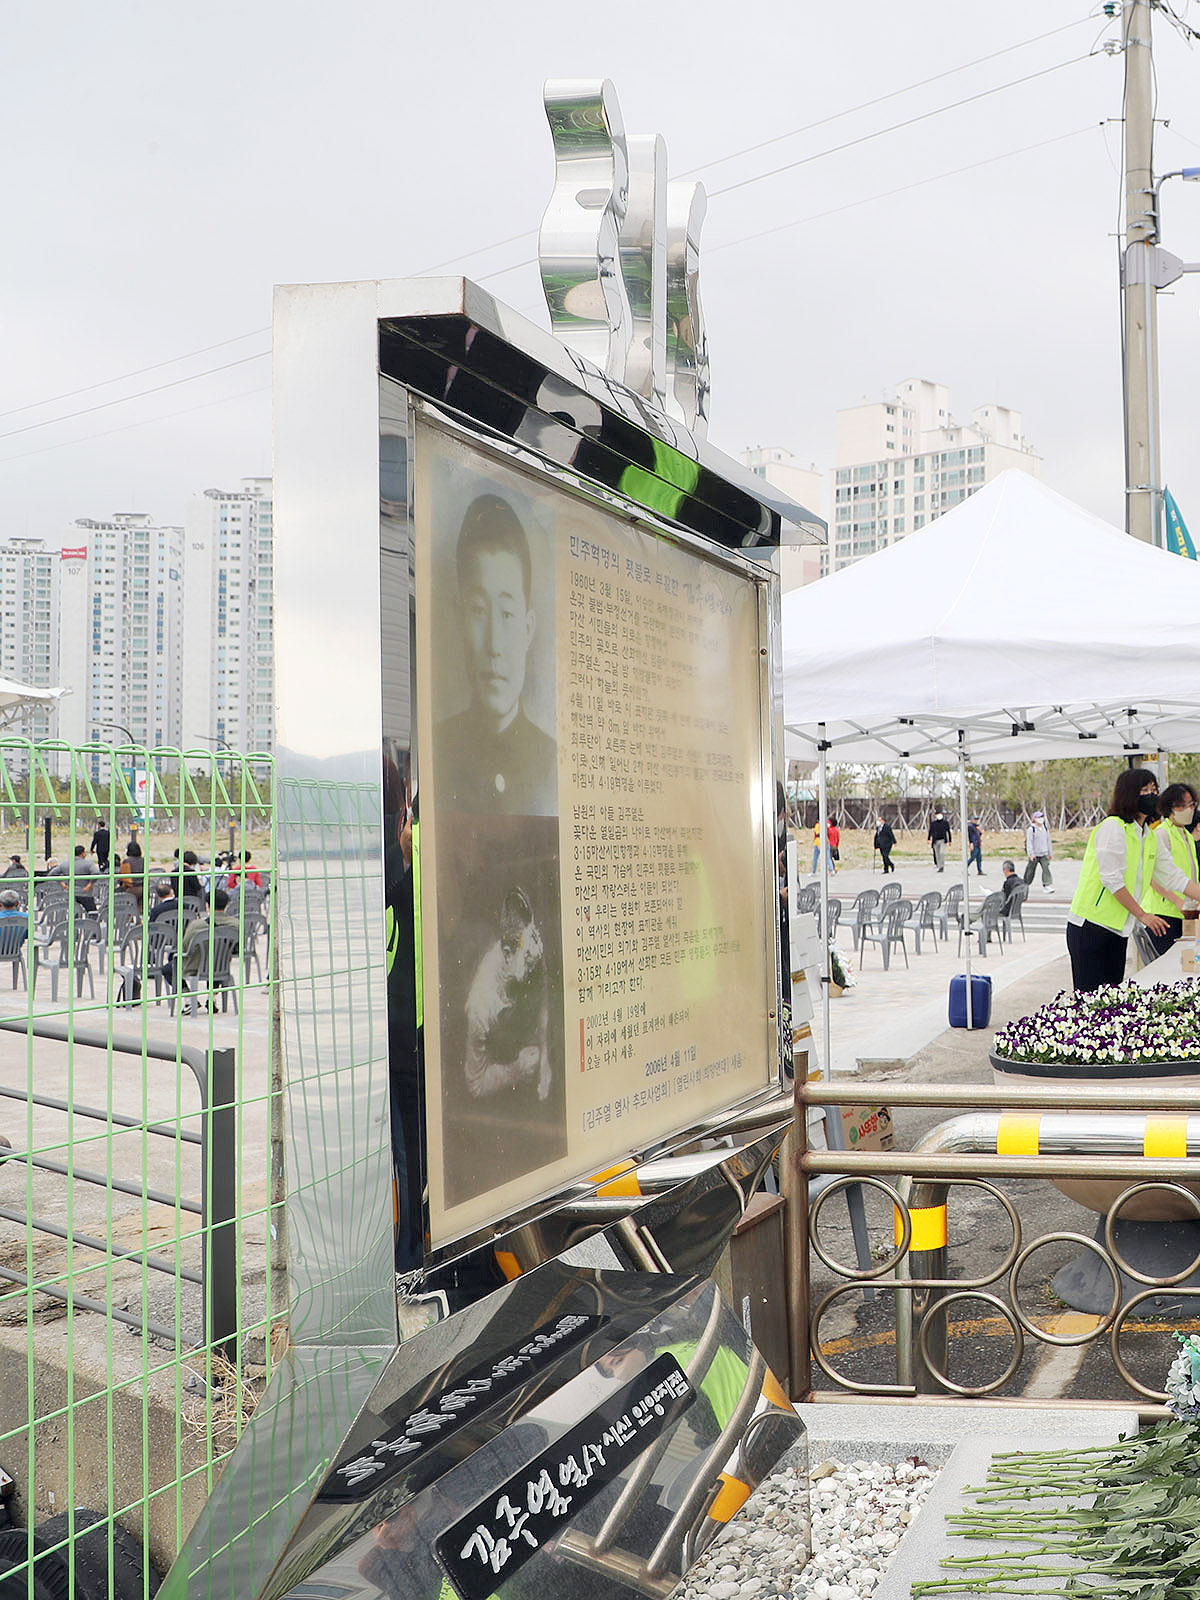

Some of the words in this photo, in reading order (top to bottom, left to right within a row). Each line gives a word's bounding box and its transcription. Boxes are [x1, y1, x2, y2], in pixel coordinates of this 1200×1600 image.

[570, 535, 620, 574] 민주혁명의
[67, 567, 81, 576] 107
[569, 590, 585, 610] 온갖
[599, 581, 612, 599] 3월
[569, 611, 585, 629] 마산
[589, 616, 618, 640] 시민들의
[570, 630, 592, 651] 민주의
[596, 638, 619, 657] 꽃으로
[570, 651, 601, 672] 김주열은
[604, 658, 619, 676] 그날
[622, 662, 629, 679] 밤
[570, 672, 593, 690] 그러나
[597, 677, 619, 695] 하늘의
[570, 692, 583, 710] 4월
[588, 695, 604, 713] 11일
[607, 700, 622, 716] 바로
[626, 703, 632, 718] 이
[598, 716, 605, 733] 약
[608, 719, 620, 735] 3m
[623, 721, 629, 736] 앞
[633, 723, 645, 738] 바다
[571, 732, 601, 752] 최루탄이
[605, 737, 627, 755] 오른쪽
[629, 741, 642, 757] 눈에
[646, 744, 658, 759] 박힌
[609, 757, 630, 774] 일어난
[633, 761, 644, 774] 2차
[646, 763, 659, 777] 마산
[572, 774, 595, 791] 마침내
[573, 804, 596, 821] 남원의
[600, 806, 615, 821] 아들
[618, 807, 644, 821] 김주열은
[573, 825, 597, 842] 꽃다운
[601, 826, 628, 841] 열일곱의
[632, 826, 650, 840] 나이로
[575, 867, 582, 881] 온
[587, 865, 609, 881] 국민의
[613, 864, 633, 879] 가슴에
[636, 863, 655, 878] 민주의
[575, 885, 598, 902] 마산의
[602, 882, 637, 899] 자랑스러운
[640, 881, 659, 896] 아들이
[576, 907, 591, 924] 이에
[595, 904, 617, 921] 우리는
[621, 901, 641, 917] 영원히
[576, 927, 584, 944] 이
[588, 924, 611, 941] 역사의
[614, 920, 635, 938] 현장에
[638, 917, 663, 933] 표지판을
[577, 942, 614, 964] 마산시민의
[618, 939, 638, 956] 의기와
[641, 935, 661, 951] 김주열
[663, 932, 680, 948] 열사의
[638, 955, 657, 972] 산화한
[660, 951, 673, 966] 모든
[674, 949, 686, 964] 민주
[578, 986, 594, 1005] 함께
[598, 979, 626, 1000] 기리고자
[630, 976, 646, 993] 한다.
[586, 1011, 609, 1032] 2002년
[612, 1008, 623, 1025] 4월
[626, 1001, 646, 1021] 19일에
[586, 1035, 594, 1052] 이
[596, 1029, 617, 1049] 자리에
[620, 1023, 640, 1043] 세웠던
[643, 1016, 666, 1036] 표지판이
[586, 1053, 601, 1072] 오늘
[604, 1048, 618, 1066] 다시
[645, 1055, 667, 1078] 2006년
[670, 1050, 681, 1069] 4월
[684, 1044, 697, 1064] 11일
[582, 1102, 611, 1133] [김주열
[614, 1095, 630, 1119] 열사
[460, 1468, 573, 1574] 김주열
[559, 1442, 606, 1488] 열사
[602, 1416, 638, 1448] 시신
[630, 1370, 691, 1428] 인양지점
